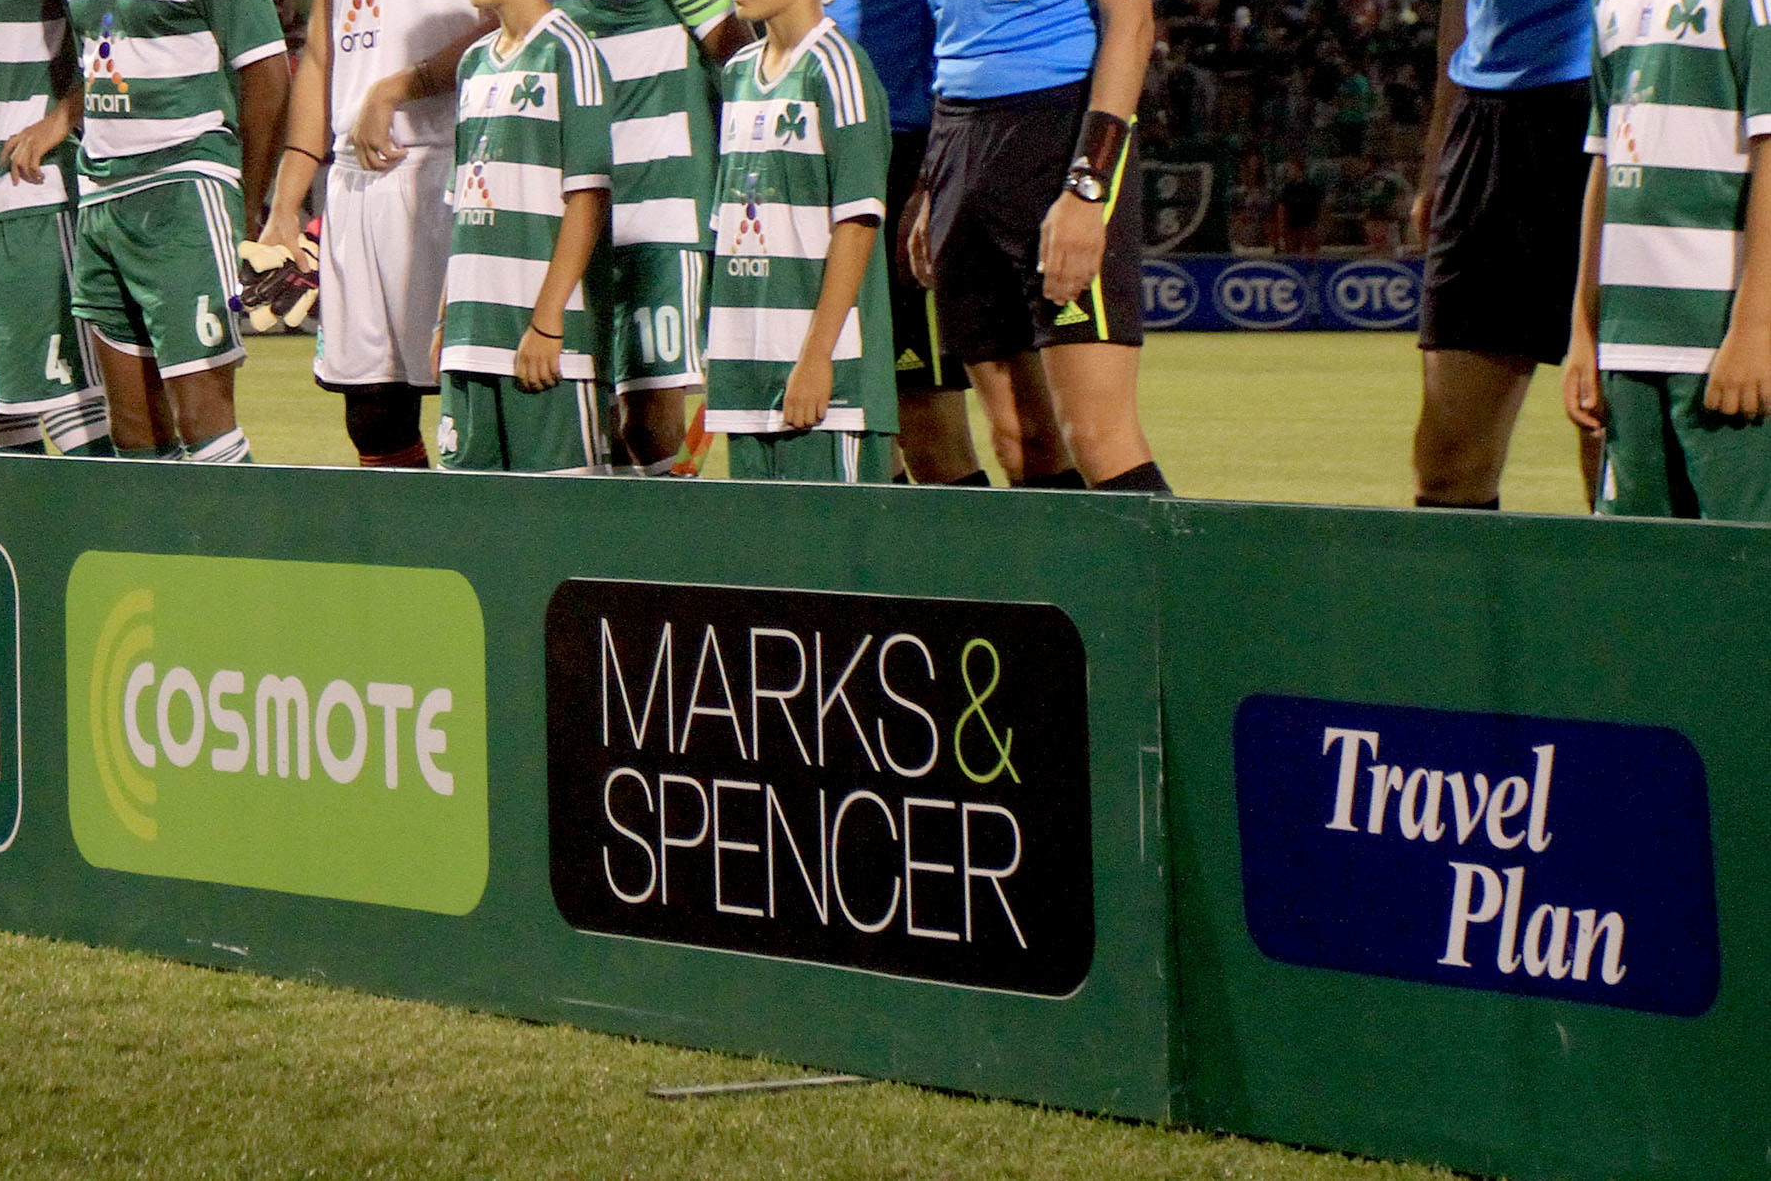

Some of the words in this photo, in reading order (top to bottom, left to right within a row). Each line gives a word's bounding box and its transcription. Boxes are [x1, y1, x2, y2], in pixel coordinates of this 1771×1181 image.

[43, 334, 74, 385] 4
[195, 294, 224, 348] 6
[633, 305, 682, 364] 10
[124, 660, 455, 797] COSMOTE
[601, 616, 939, 778] MARKS
[954, 636, 1022, 785] &
[1322, 726, 1553, 854] Travel
[601, 766, 1028, 950] SPENCER
[1437, 862, 1626, 986] Plan
